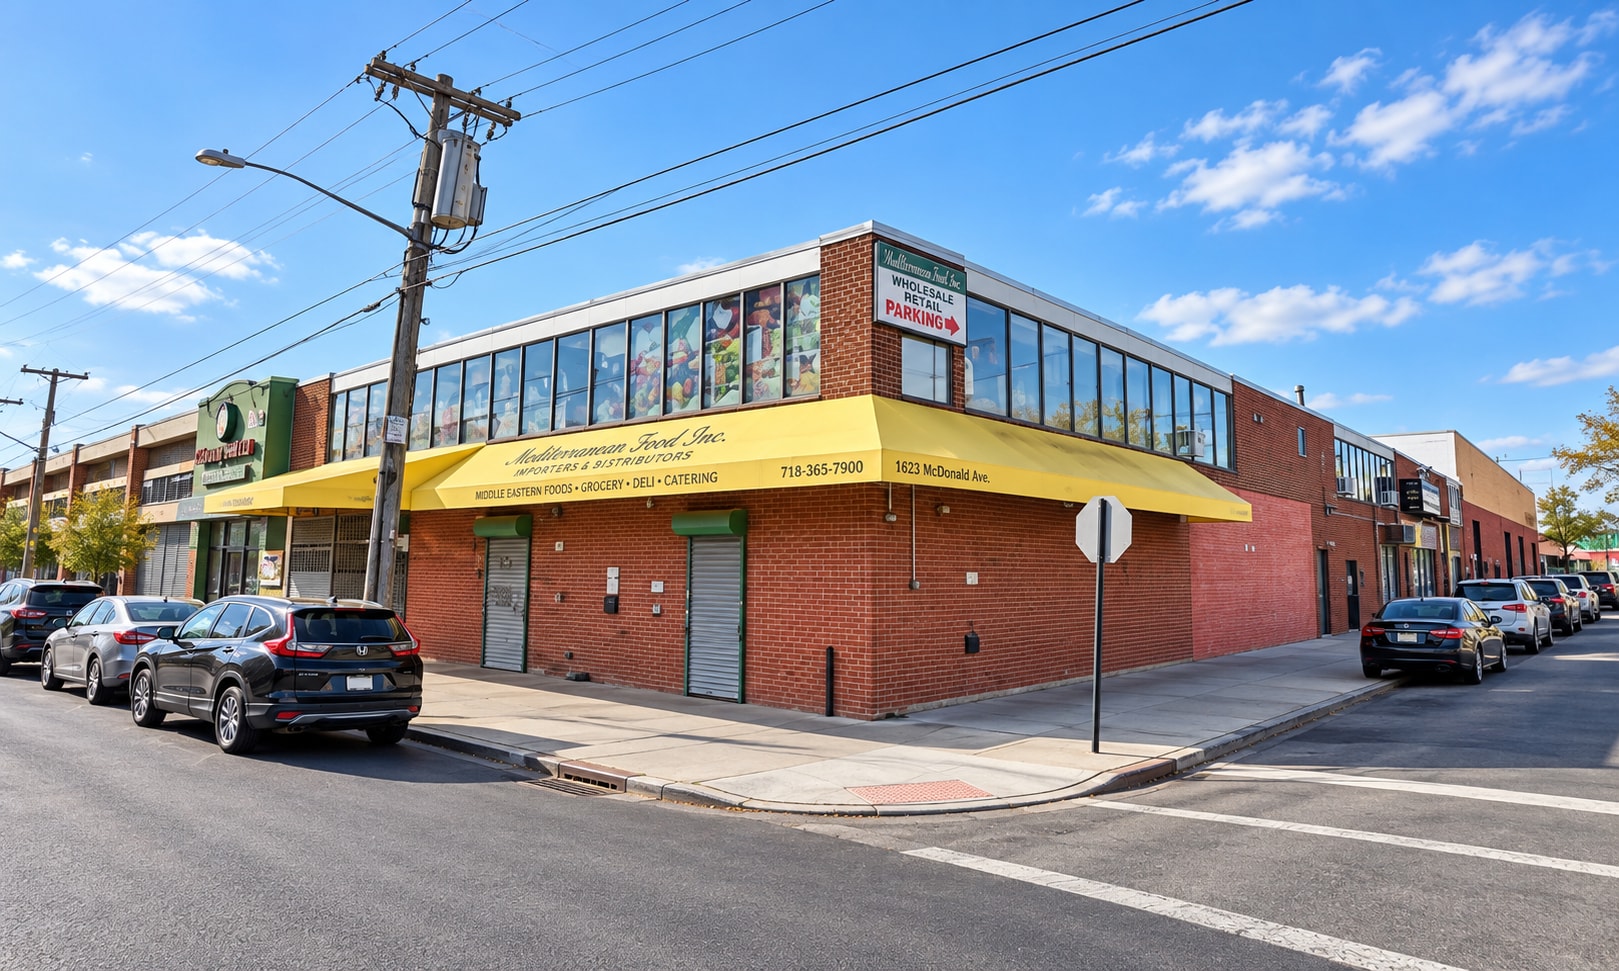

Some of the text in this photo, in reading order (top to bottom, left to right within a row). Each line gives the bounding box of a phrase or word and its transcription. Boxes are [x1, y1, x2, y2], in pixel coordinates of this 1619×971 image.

[892, 274, 954, 305] WHOLESALE
[904, 291, 942, 313] RETAIL
[885, 298, 943, 331] PARKING
[630, 428, 690, 453] Food
[683, 425, 726, 447] Inc.
[780, 460, 863, 478] 718-365-7900
[895, 460, 990, 484] 1623 McDonald Ave.
[506, 486, 542, 499] EASTERN
[544, 483, 573, 496] FOODS
[581, 478, 624, 493] GROCERY
[632, 475, 655, 489] DELI
[664, 471, 718, 487] CATERING
